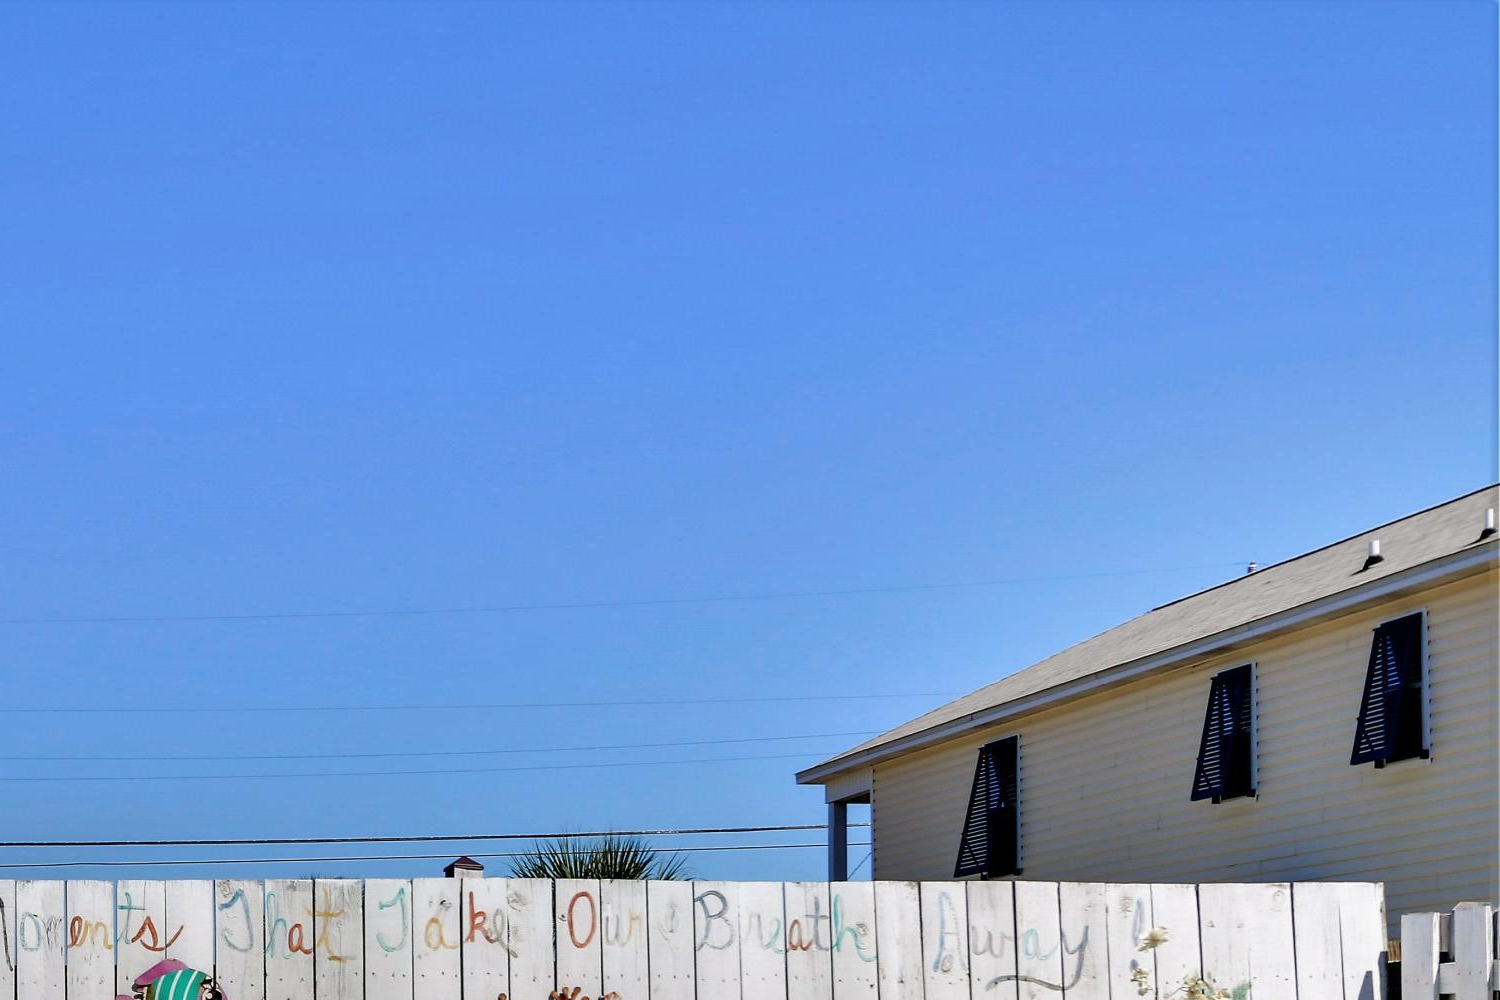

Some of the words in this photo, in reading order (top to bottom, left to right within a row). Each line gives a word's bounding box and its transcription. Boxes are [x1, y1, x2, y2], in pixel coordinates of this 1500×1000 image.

[218, 887, 356, 963] That
[375, 886, 518, 958] Take
[567, 891, 642, 949] Our
[694, 889, 877, 962] Breath
